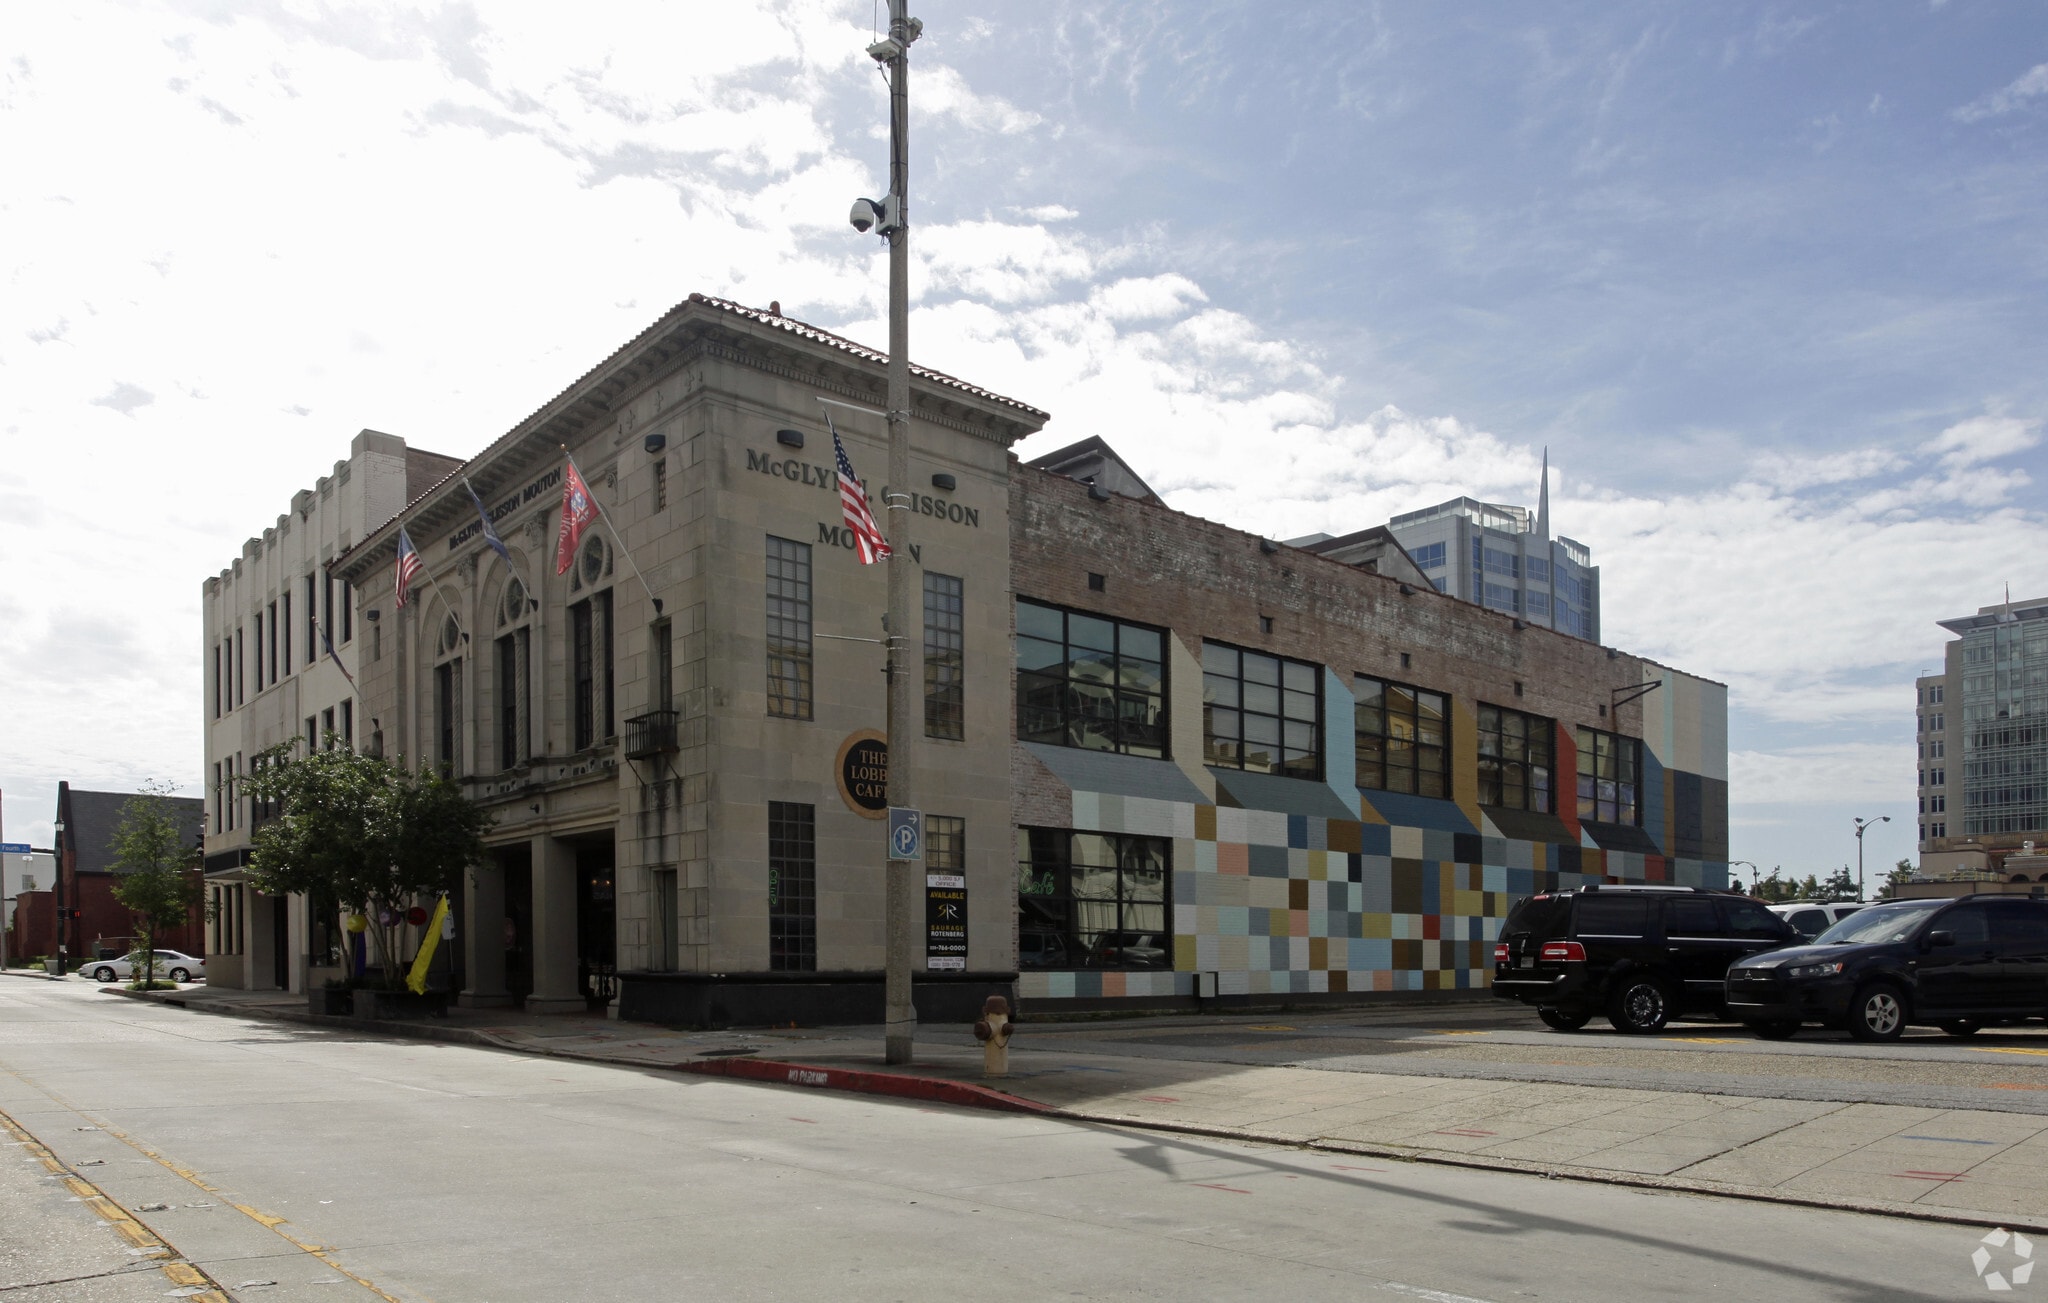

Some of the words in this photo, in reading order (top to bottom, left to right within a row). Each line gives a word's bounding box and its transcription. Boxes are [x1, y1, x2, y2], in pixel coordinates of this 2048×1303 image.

[524, 467, 561, 504] MOUTON
[859, 749, 887, 766] THE
[851, 764, 888, 783] LOBB
[901, 829, 912, 850] P
[930, 891, 964, 899] AVAILABLE
[788, 1069, 798, 1081] NO
[800, 1070, 828, 1084] PARKING
